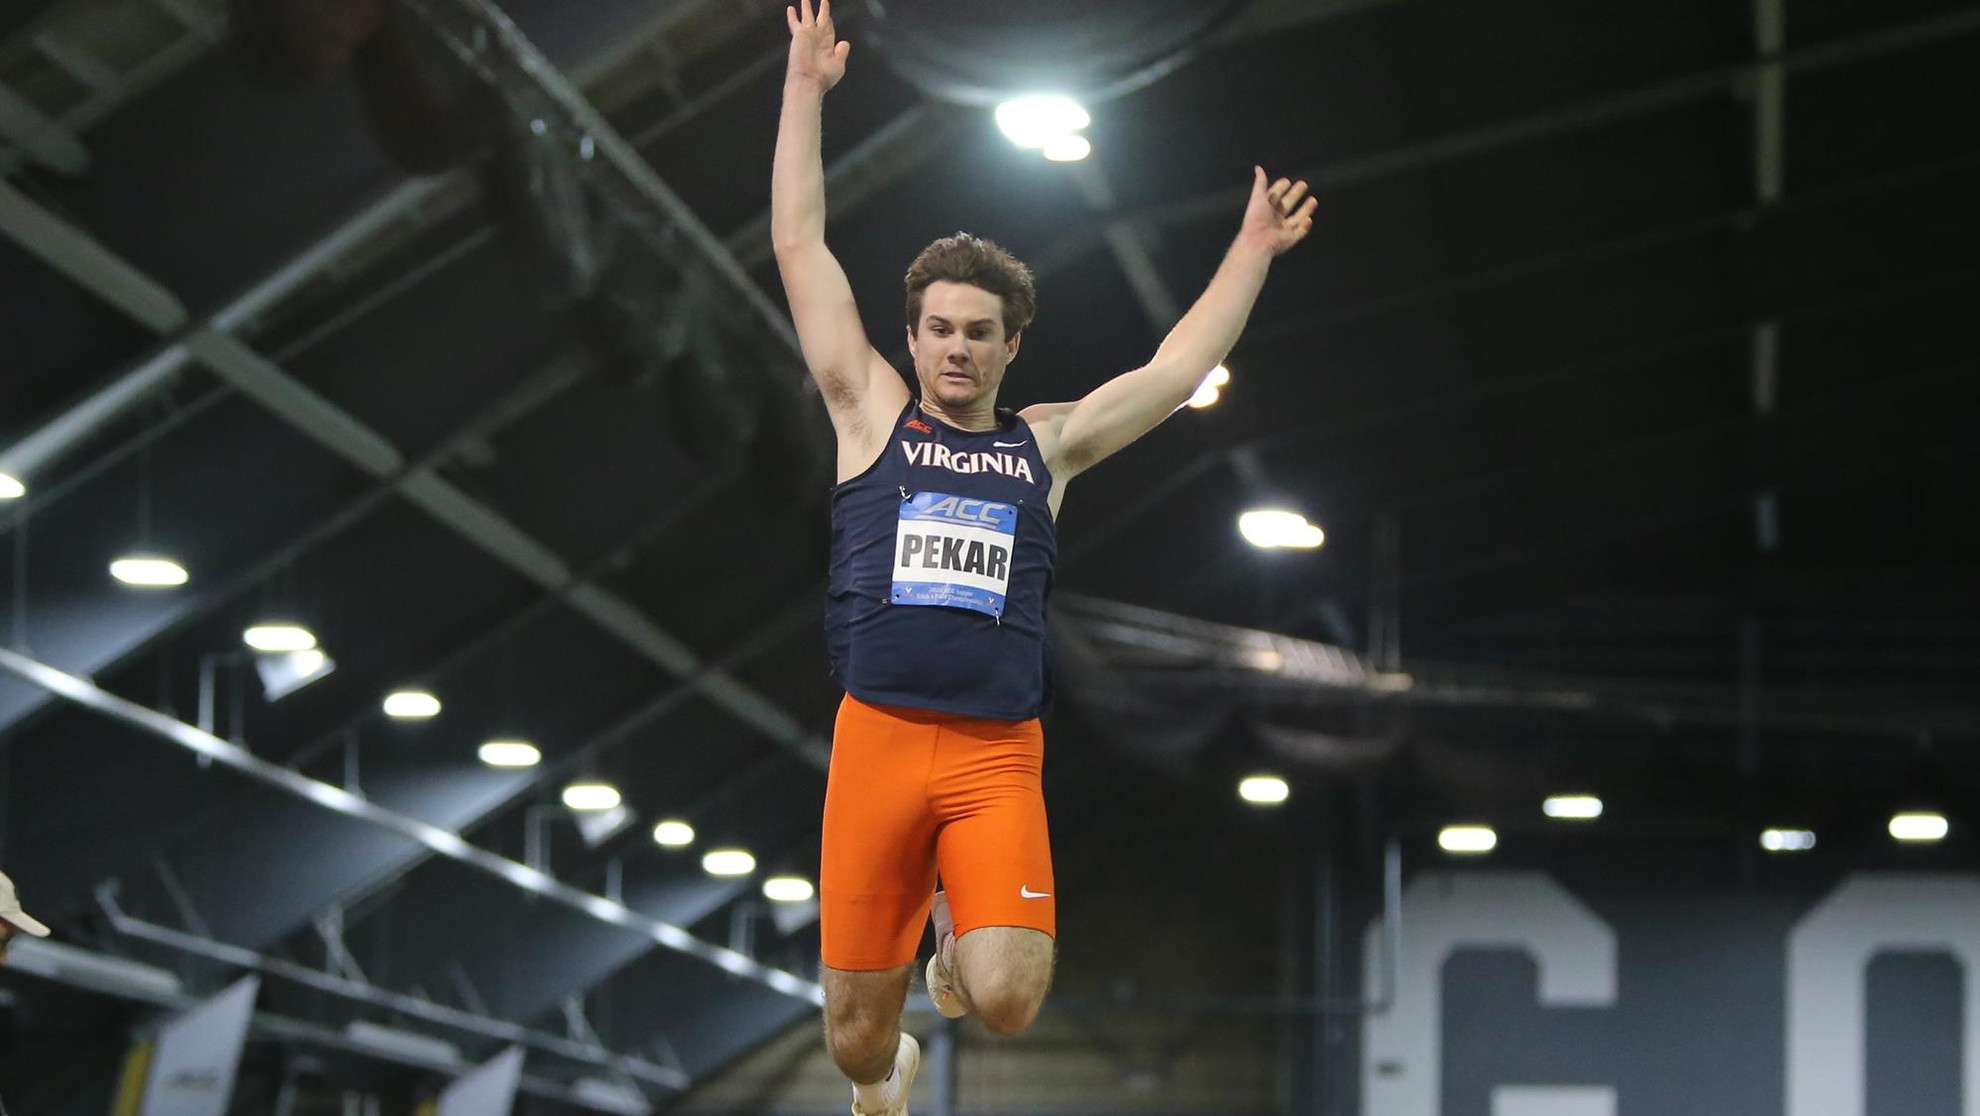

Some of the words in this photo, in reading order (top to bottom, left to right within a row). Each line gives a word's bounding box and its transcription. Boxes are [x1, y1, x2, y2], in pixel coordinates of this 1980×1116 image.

[901, 441, 1034, 484] VIRGINIA
[921, 496, 1007, 525] ACC
[902, 534, 1008, 581] PEKAR
